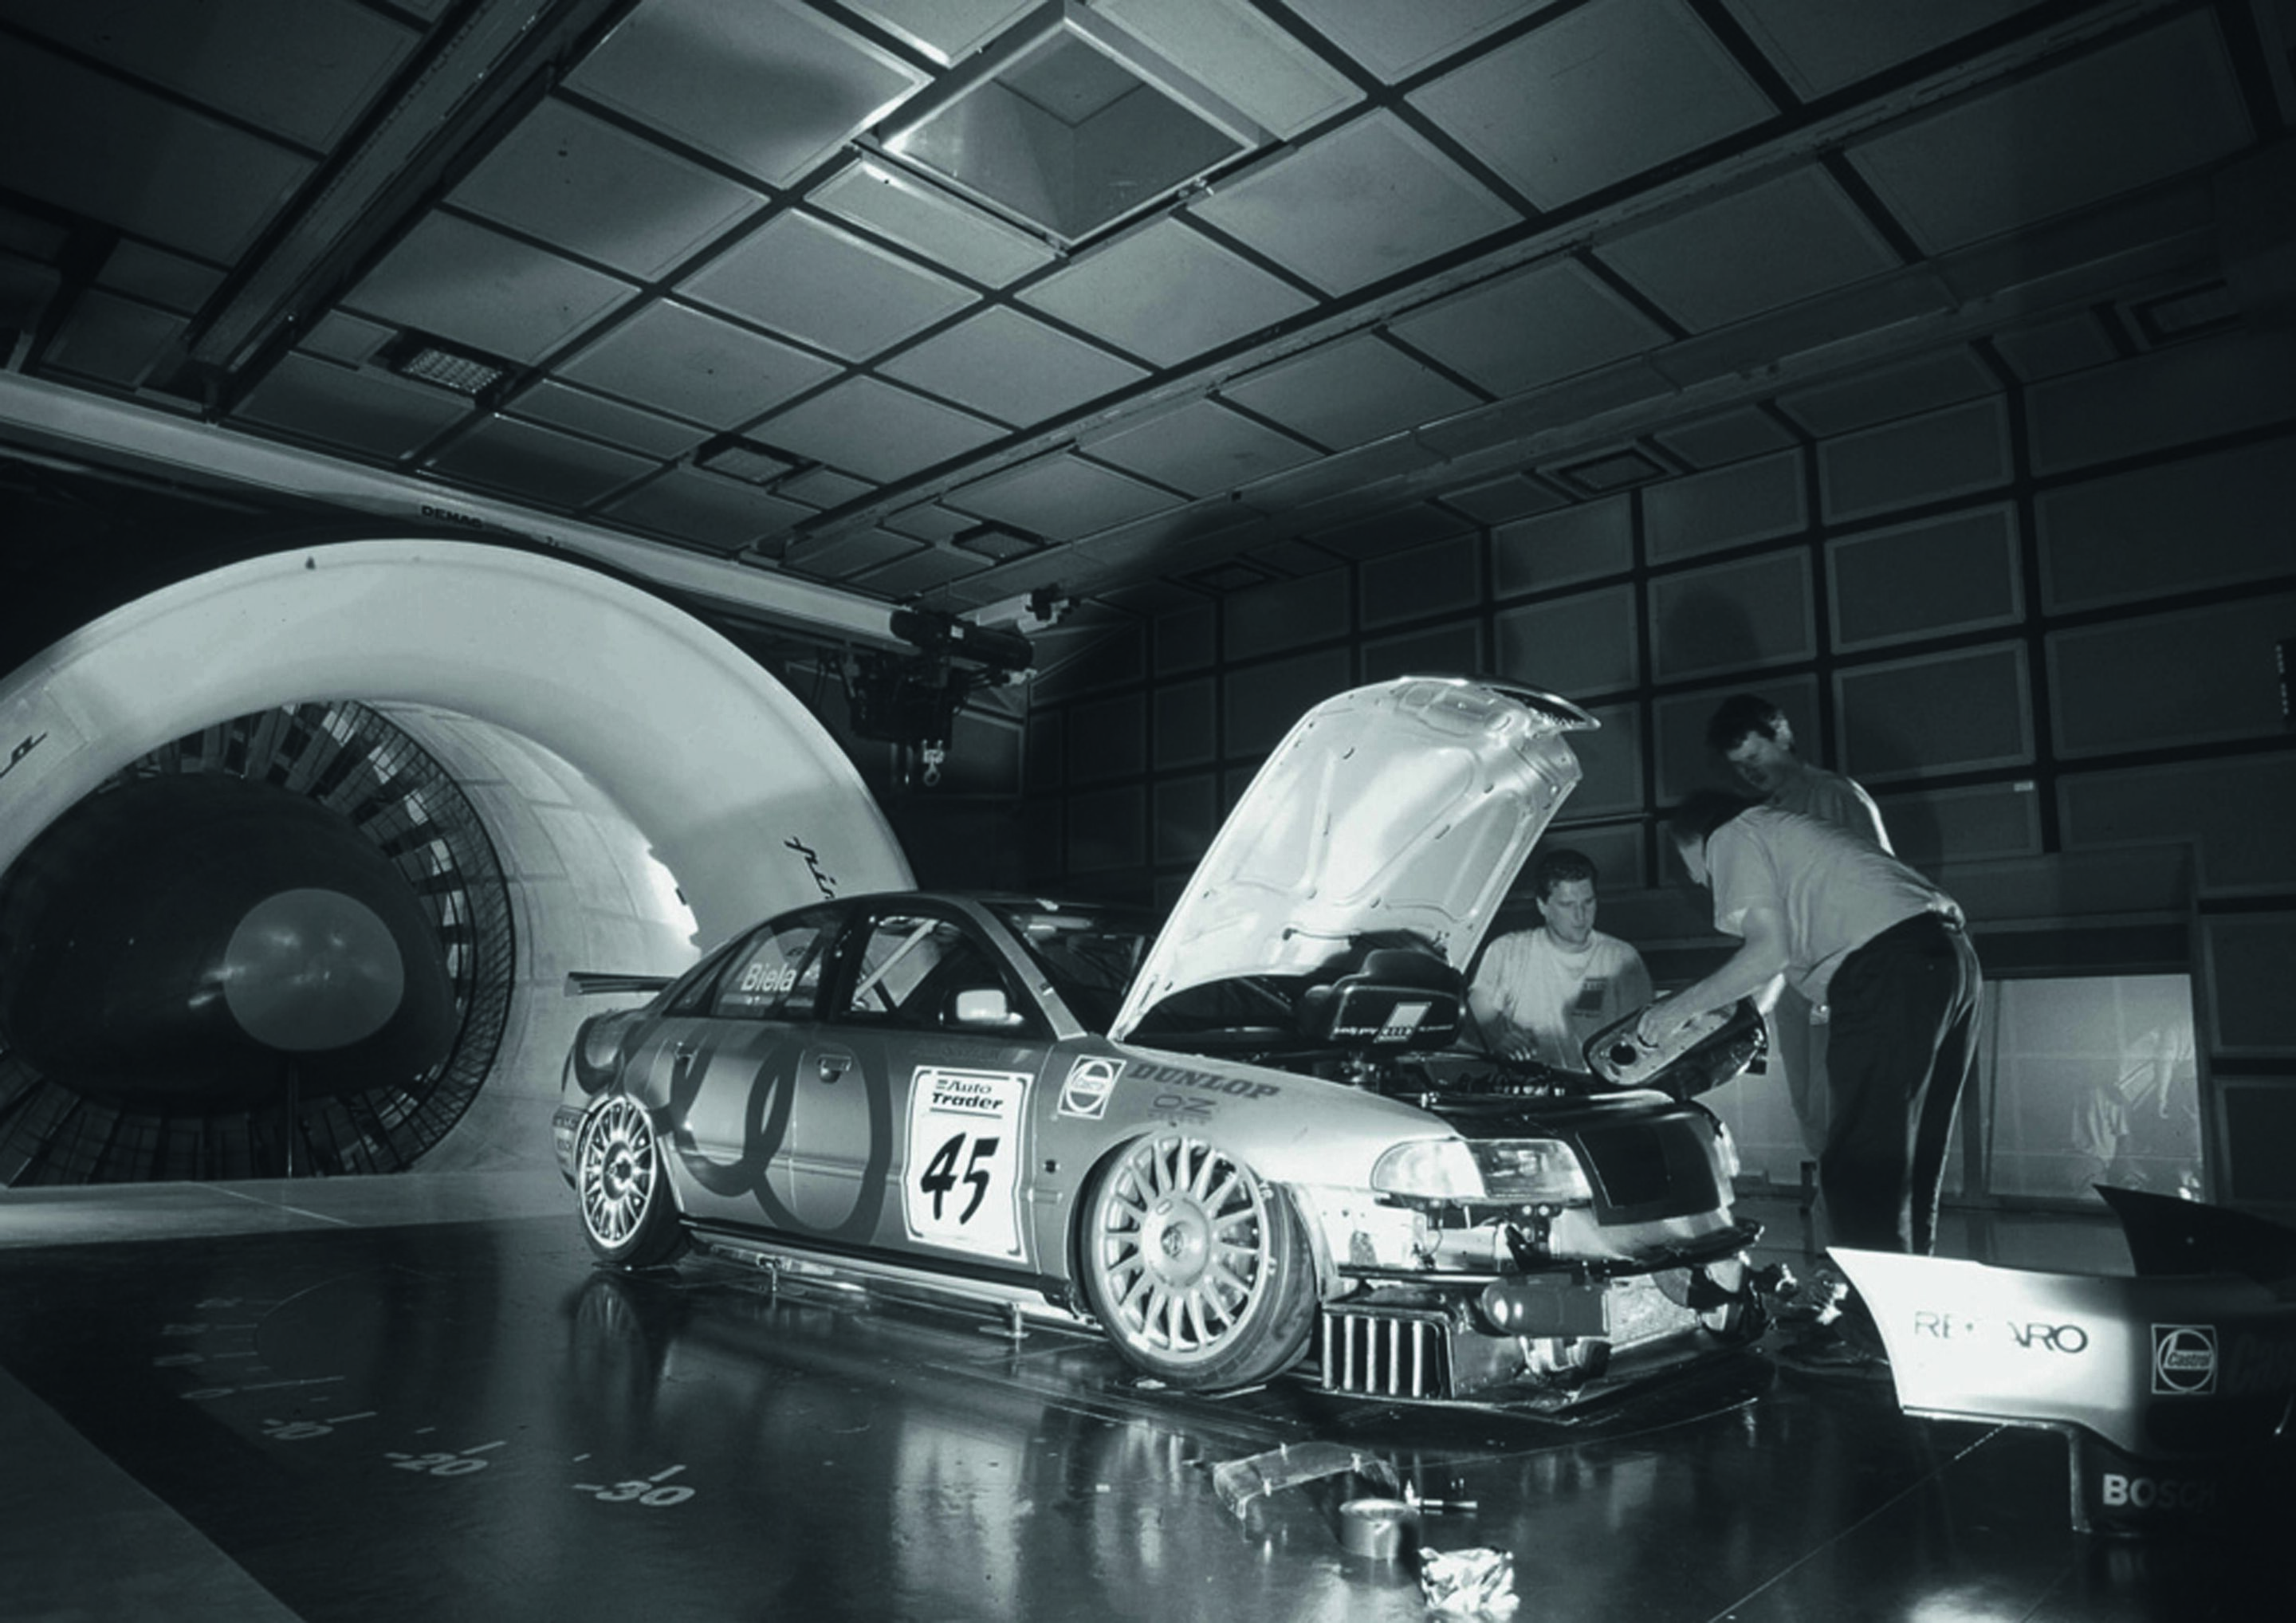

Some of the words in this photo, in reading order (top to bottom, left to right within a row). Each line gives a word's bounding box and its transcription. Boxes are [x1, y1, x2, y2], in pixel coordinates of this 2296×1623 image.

[741, 962, 797, 992] Biela
[946, 1079, 993, 1094] Auto
[1130, 1063, 1280, 1100] DUNLOP
[932, 1092, 1004, 1110] Trader
[920, 1131, 1000, 1225] 45
[571, 1480, 696, 1507] -30
